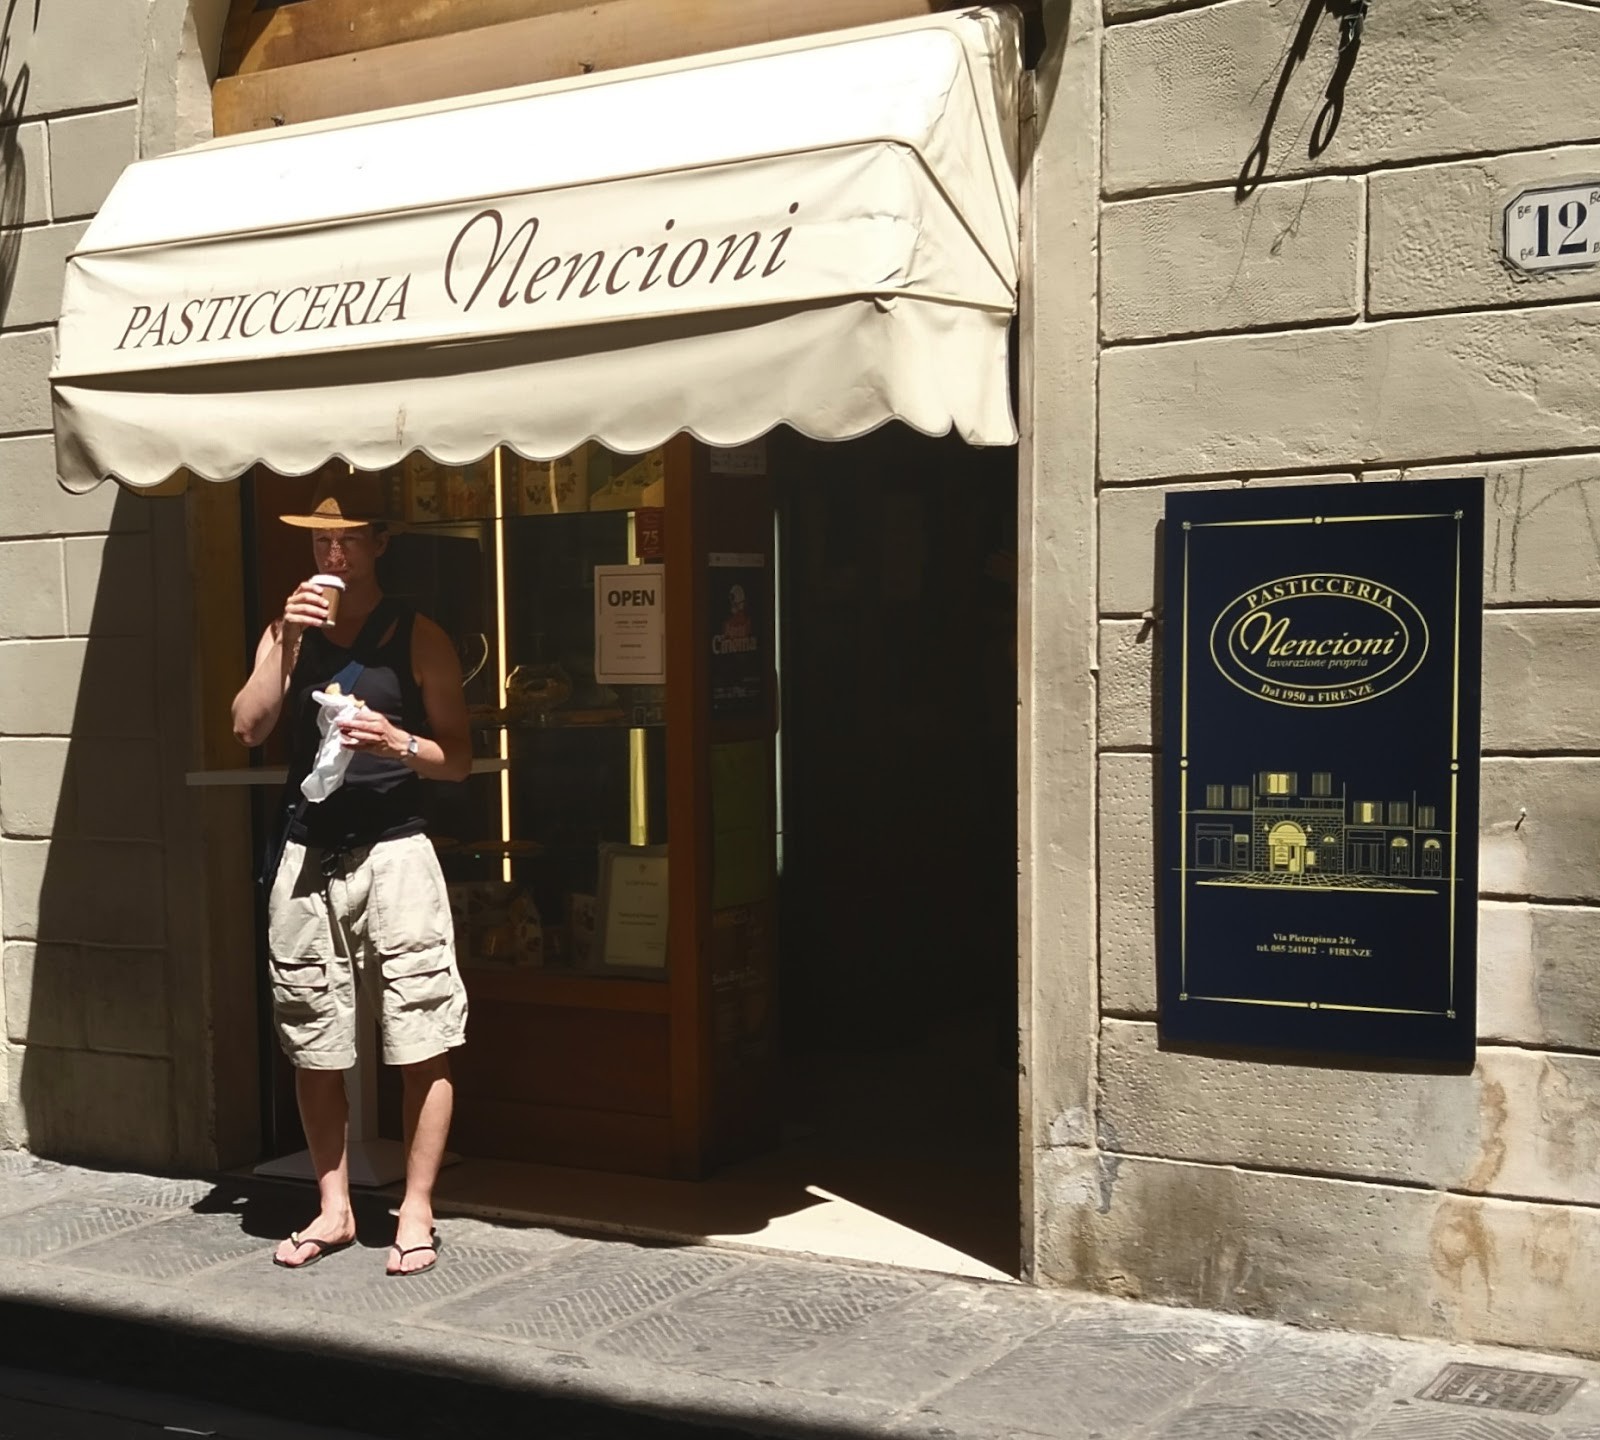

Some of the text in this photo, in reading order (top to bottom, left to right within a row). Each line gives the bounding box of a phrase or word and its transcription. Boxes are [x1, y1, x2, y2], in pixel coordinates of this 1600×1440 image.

[1534, 200, 1588, 258] 12
[113, 201, 800, 351] PASTICCERIA Nencioni
[641, 529, 659, 547] 75
[607, 589, 656, 607] OPEN
[1246, 577, 1395, 609] PASTICCERIA
[1240, 611, 1400, 656] Nencioni
[1266, 656, 1369, 670] lavorazione propria
[1261, 683, 1375, 702] Dal 1950 a FIRENZE
[1273, 933, 1288, 942] Via
[1288, 934, 1337, 945] Pietrapiana
[1270, 944, 1287, 953] 055
[1328, 947, 1373, 957] FIRENZE
